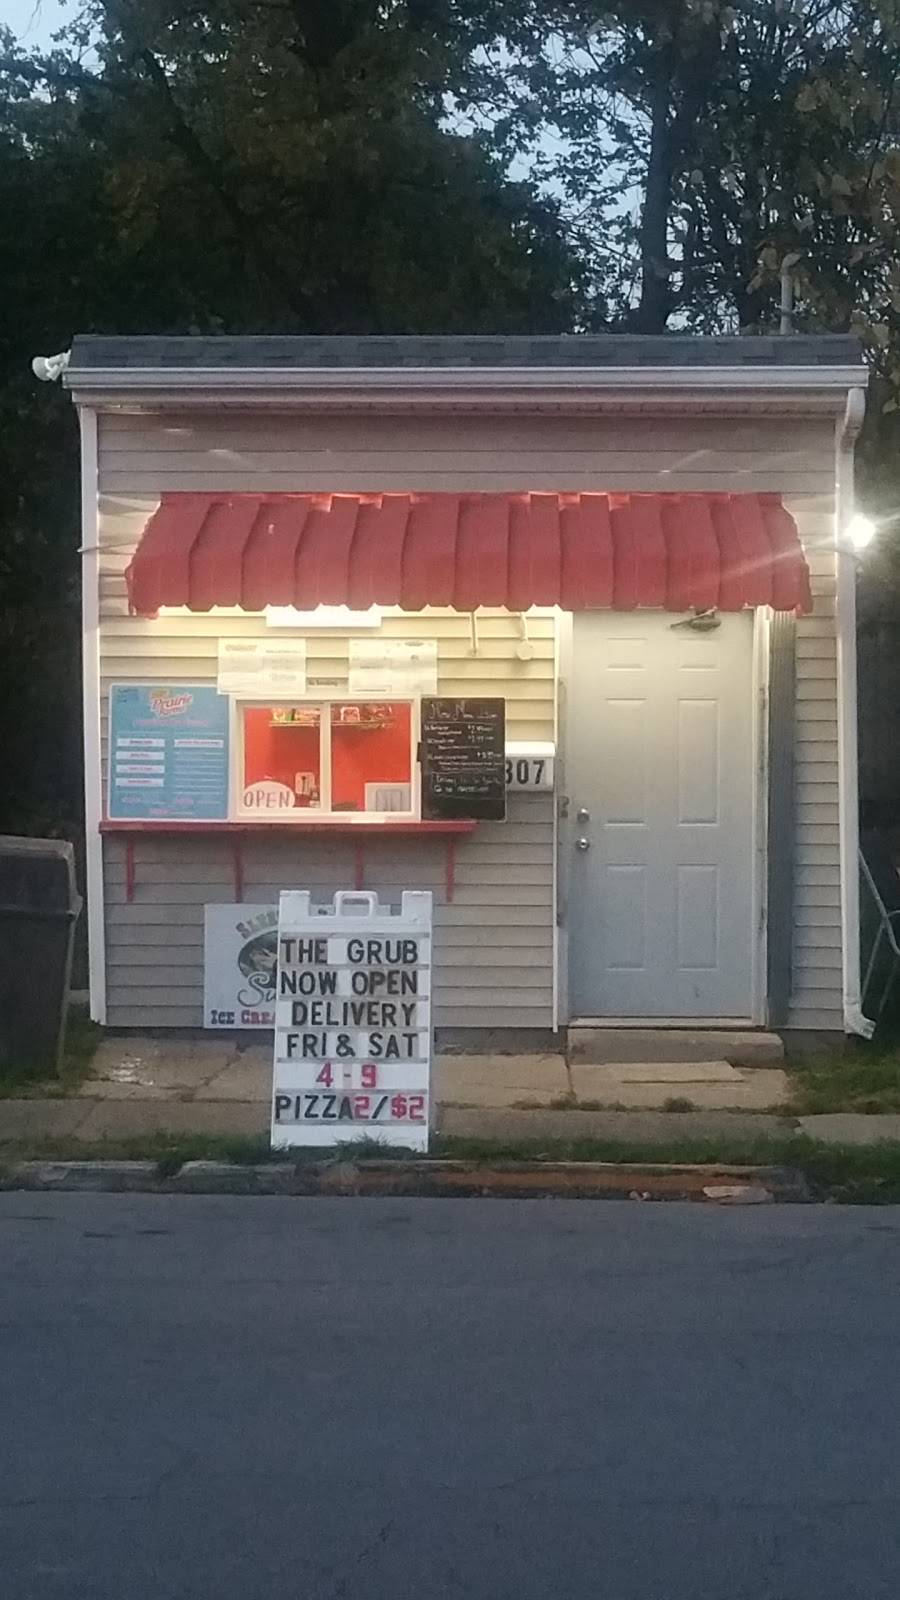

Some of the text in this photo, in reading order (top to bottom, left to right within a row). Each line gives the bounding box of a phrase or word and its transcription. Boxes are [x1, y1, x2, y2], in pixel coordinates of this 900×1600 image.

[243, 791, 290, 808] OPEN
[280, 939, 418, 964] THE GRUB
[280, 970, 418, 996] NOW OPEN
[241, 1009, 276, 1025] CRE
[291, 1002, 417, 1027] DELIVERY
[368, 1032, 418, 1058] SAT
